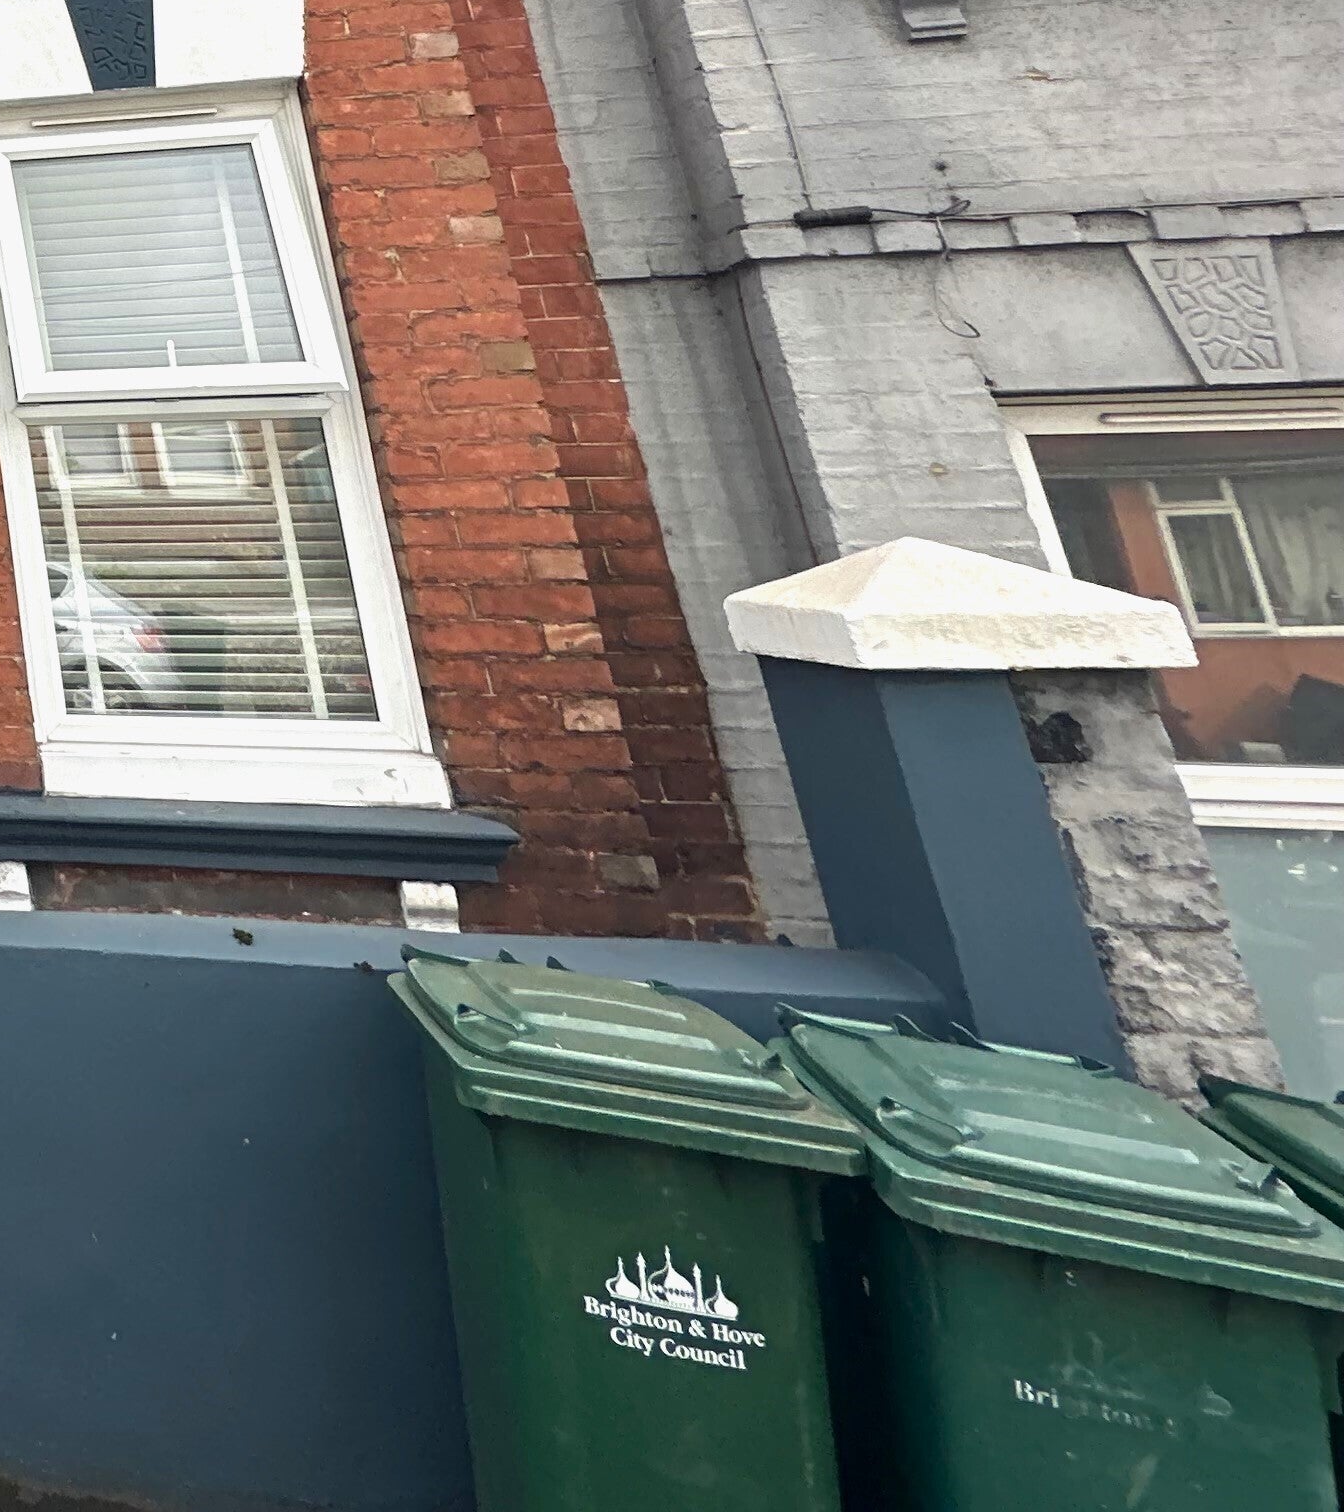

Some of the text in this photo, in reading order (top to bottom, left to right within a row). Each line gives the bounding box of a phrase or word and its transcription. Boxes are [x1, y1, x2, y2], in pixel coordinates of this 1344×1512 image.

[583, 1295, 767, 1348] Brighton & Hove
[610, 1326, 748, 1370] City Council
